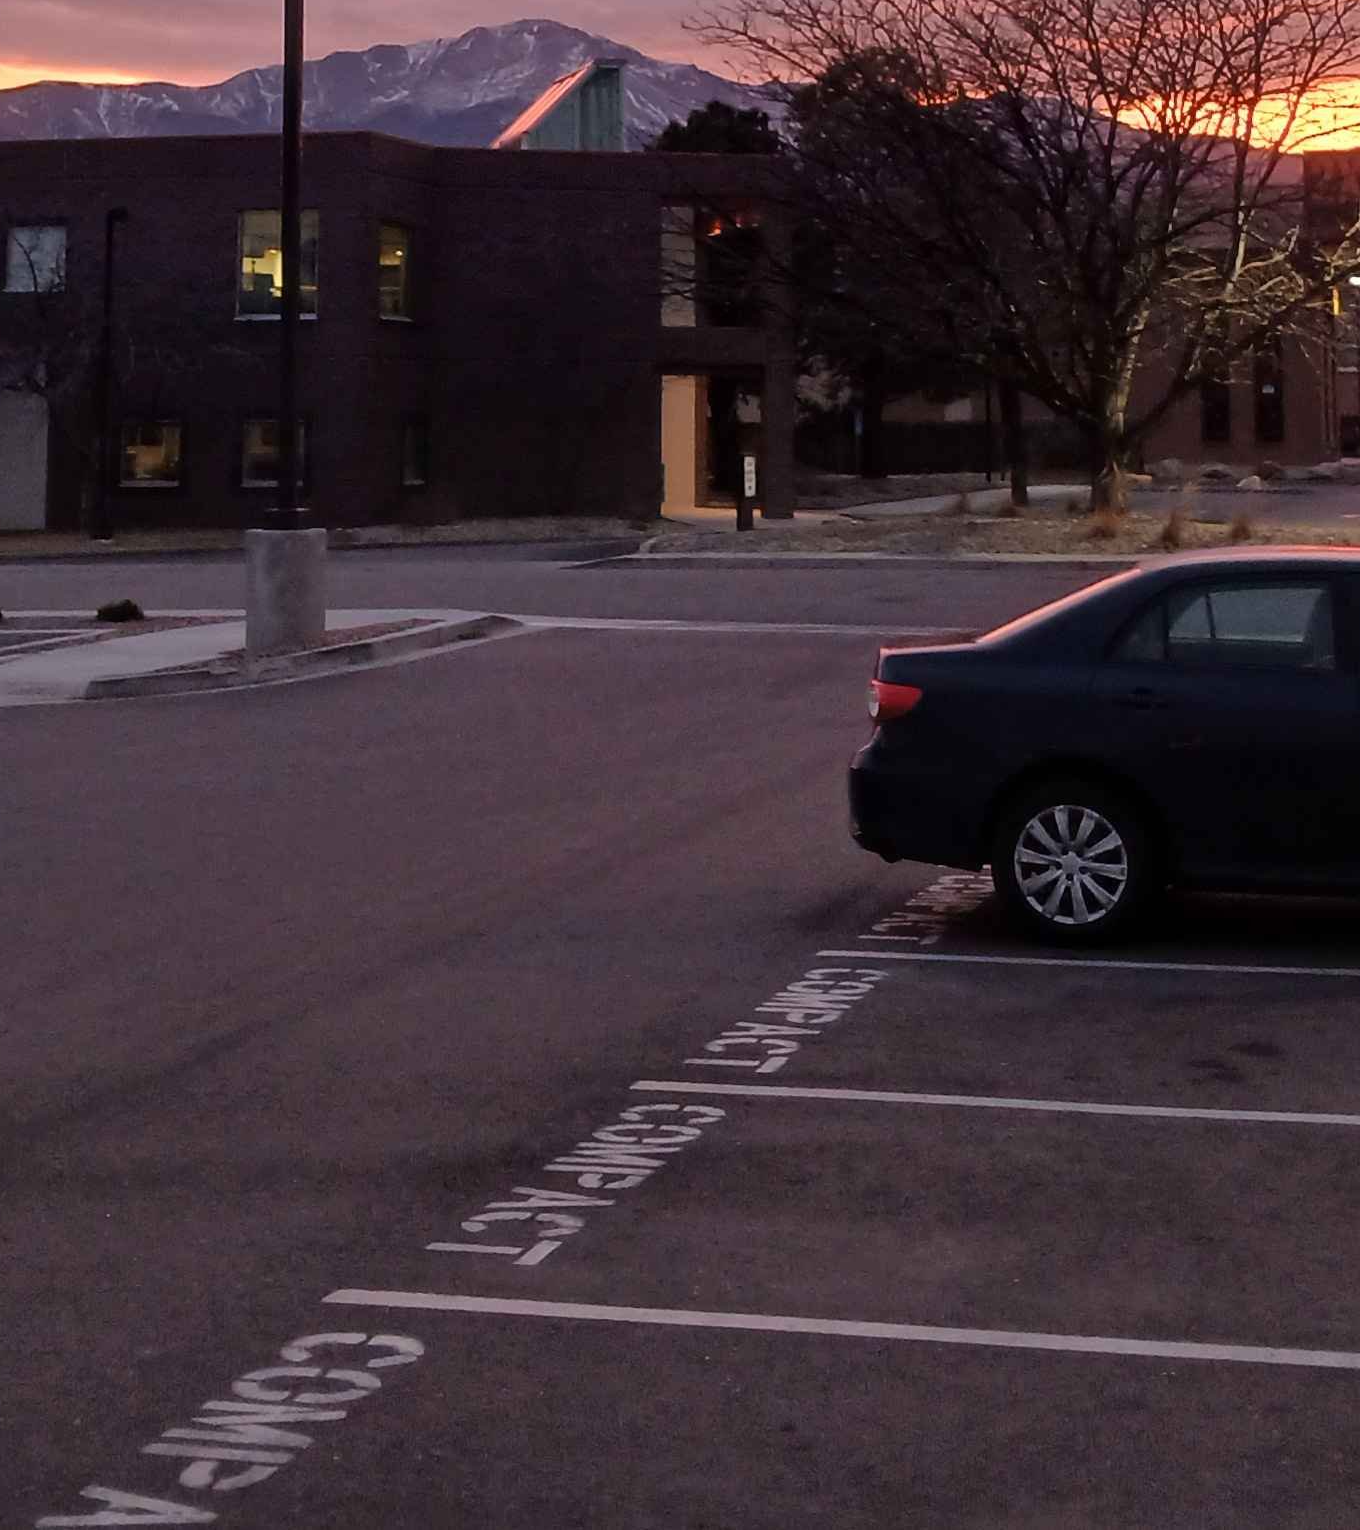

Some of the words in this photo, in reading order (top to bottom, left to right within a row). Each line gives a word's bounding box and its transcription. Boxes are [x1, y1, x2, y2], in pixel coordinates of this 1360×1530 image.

[683, 968, 889, 1073] COMPACT
[425, 1104, 727, 1266] COMPACT
[36, 1332, 425, 1528] COMPA
